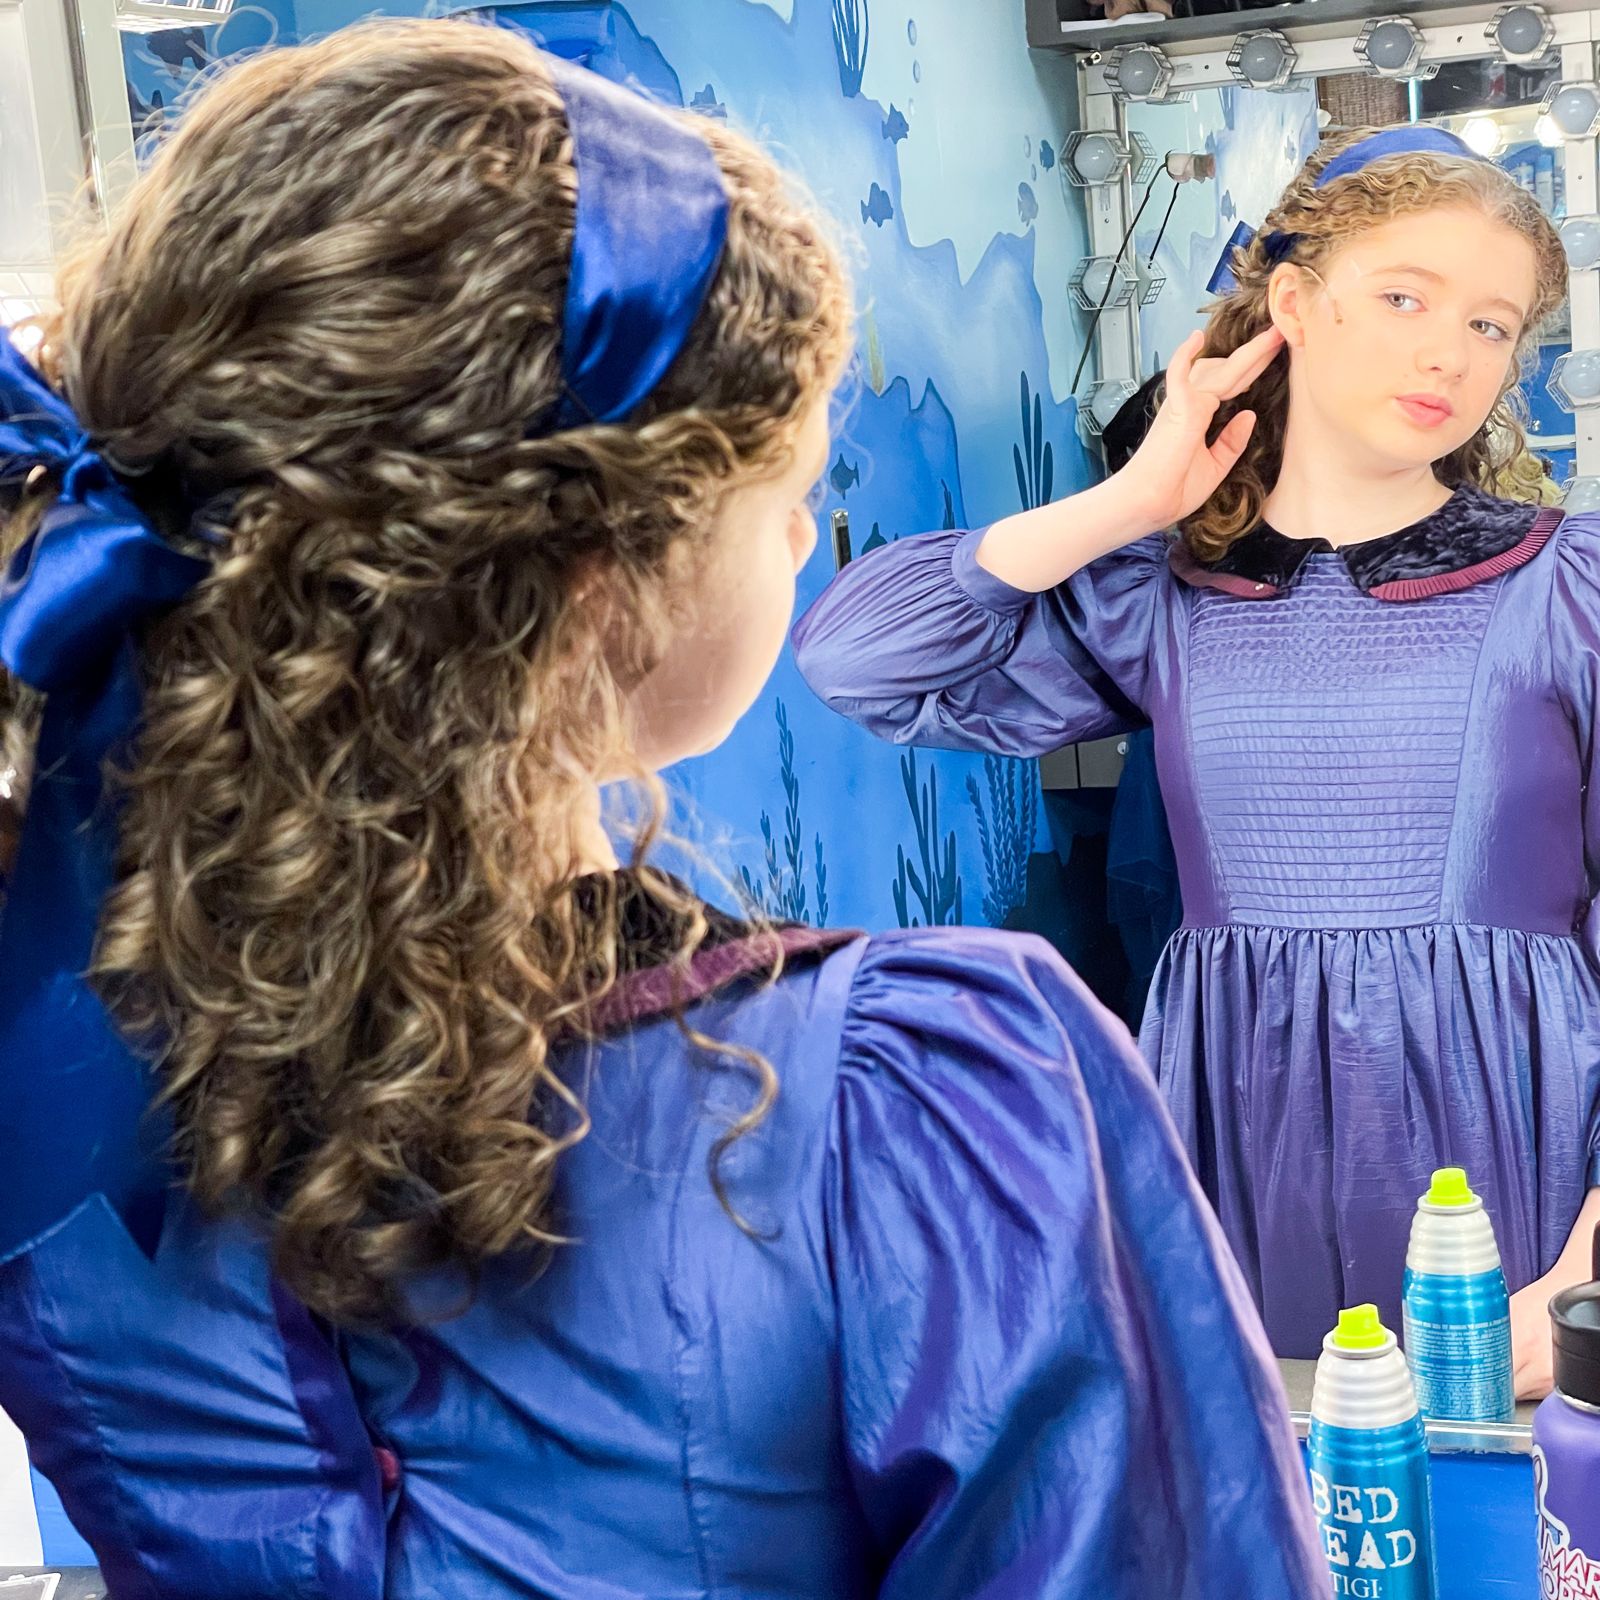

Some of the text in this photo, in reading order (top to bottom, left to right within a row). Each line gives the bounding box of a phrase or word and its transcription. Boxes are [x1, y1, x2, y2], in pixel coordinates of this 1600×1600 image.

[1310, 1469, 1399, 1524] BED
[1316, 1516, 1417, 1570] EAD
[1329, 1570, 1381, 1599] TIGI
